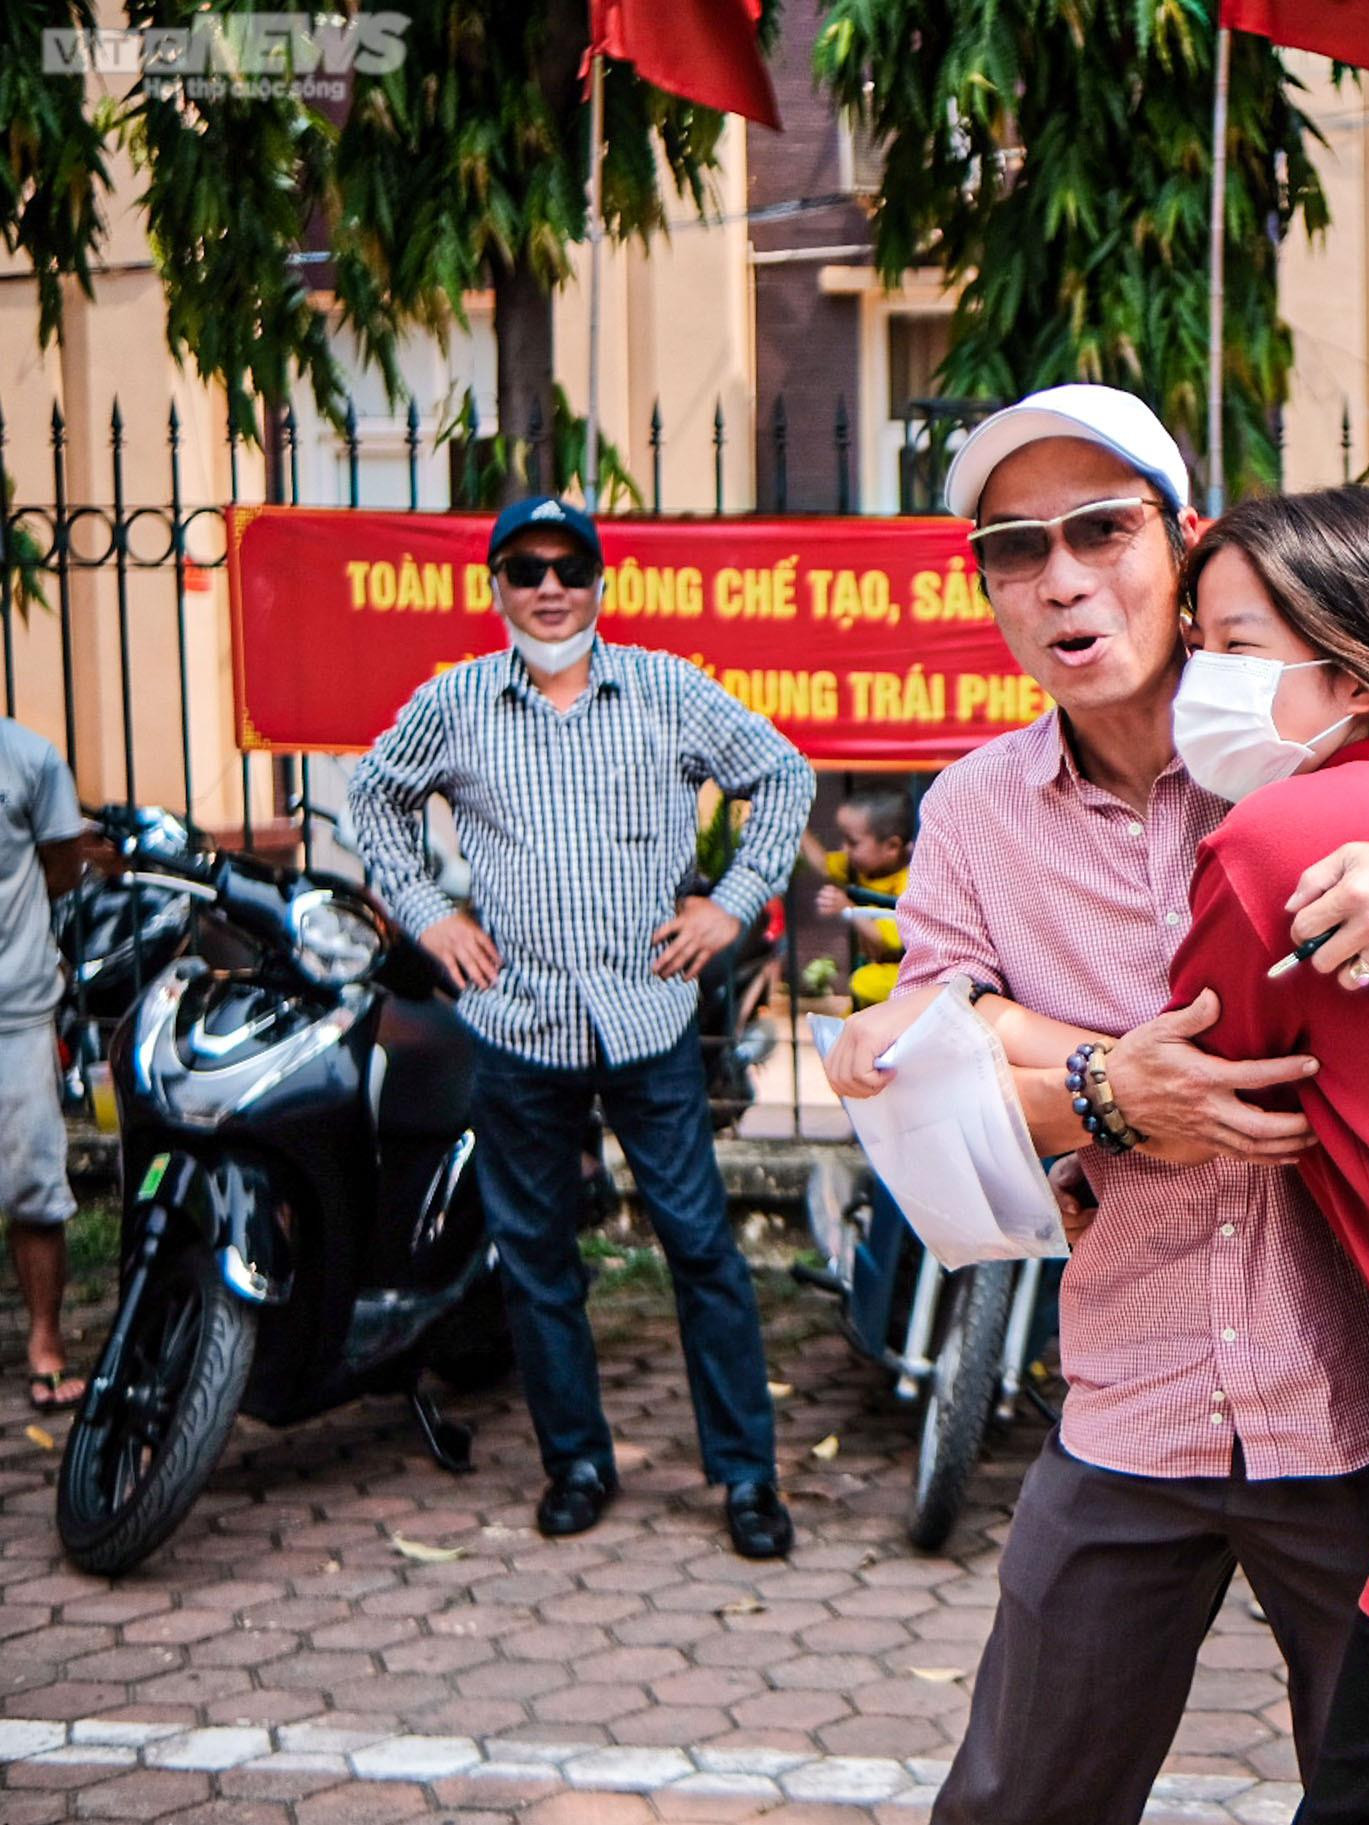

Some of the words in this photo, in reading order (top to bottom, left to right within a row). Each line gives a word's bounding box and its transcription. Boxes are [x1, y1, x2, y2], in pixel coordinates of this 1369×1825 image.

[346, 553, 454, 613] TOÀN
[714, 554, 799, 618] CHẾ
[807, 569, 899, 630] TẠO,
[848, 663, 945, 721] TRÁI
